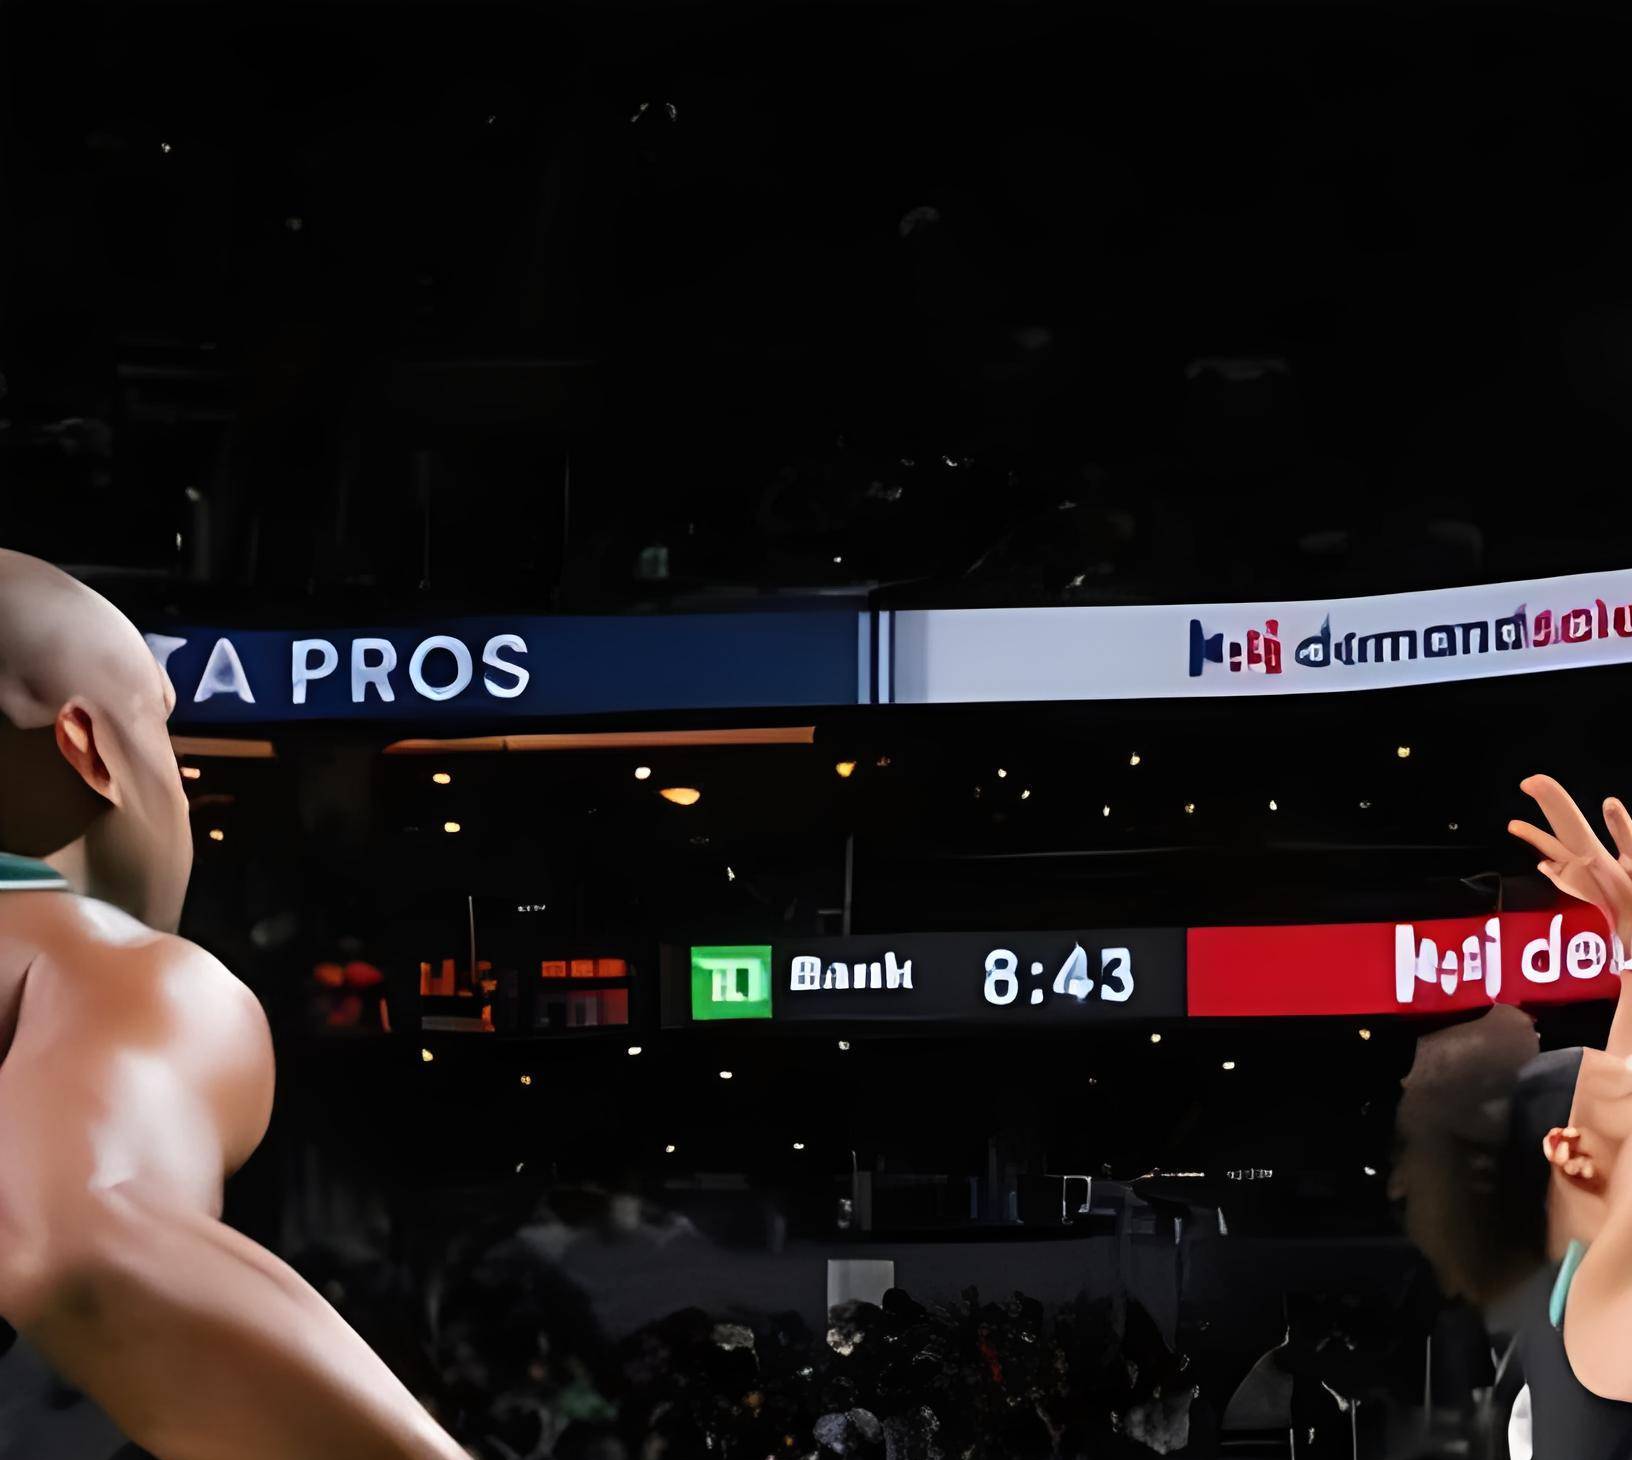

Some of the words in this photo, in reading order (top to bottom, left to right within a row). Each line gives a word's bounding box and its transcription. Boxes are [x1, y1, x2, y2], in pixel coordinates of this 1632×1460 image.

[292, 633, 530, 704] PROS
[789, 951, 914, 991] Bank
[983, 940, 1136, 1005] 8:43
